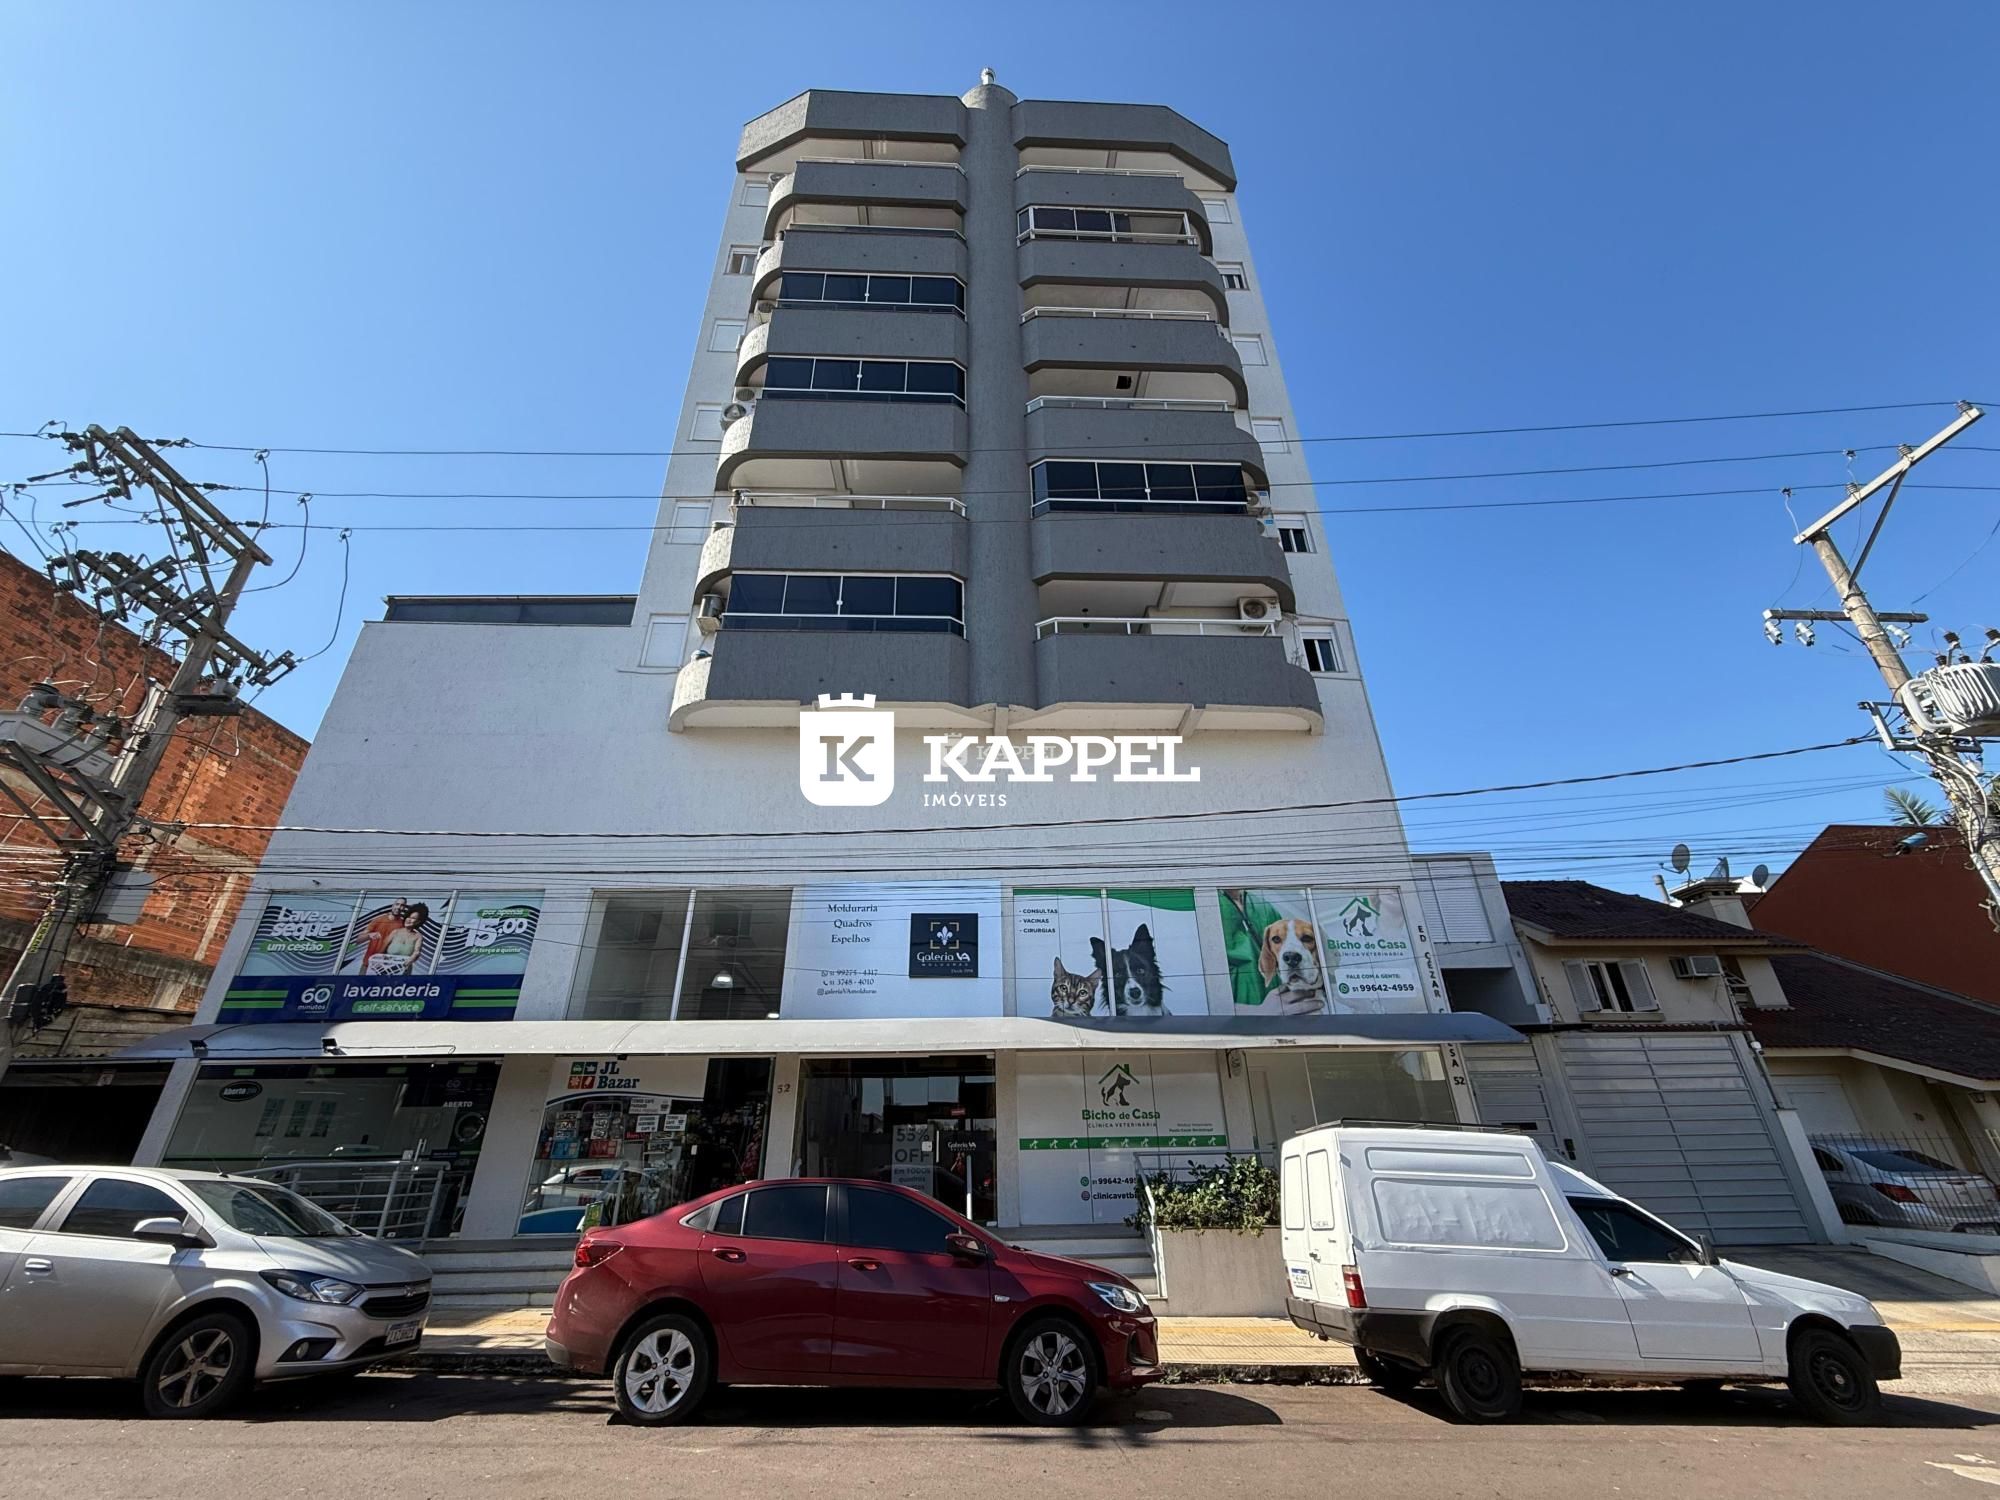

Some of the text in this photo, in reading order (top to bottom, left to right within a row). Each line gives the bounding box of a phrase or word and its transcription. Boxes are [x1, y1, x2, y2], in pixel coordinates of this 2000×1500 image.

[828, 903, 879, 913] Molduraria
[277, 906, 319, 922] Lave
[833, 918, 873, 929] Quadros
[831, 934, 872, 945] Espelhos
[1327, 939, 1361, 950] Bicho
[1377, 938, 1407, 950] Casa
[266, 941, 325, 952] um cestão
[916, 951, 954, 963] Galeria
[342, 983, 441, 998] lavanderia
[1360, 983, 1415, 992] 99642-4959
[301, 987, 331, 1004] 60
[357, 1002, 420, 1013] self-service
[600, 1061, 620, 1075] JL
[597, 1075, 640, 1089] Bazar
[1453, 1076, 1466, 1086] 52
[777, 1083, 791, 1094] 52
[1081, 1108, 1161, 1121] Bicho de Casa
[896, 1128, 930, 1142] 55%
[894, 1148, 930, 1163] OFF
[1098, 1177, 1137, 1185] 99642-49
[1092, 1191, 1137, 1200] clinicavetbi
